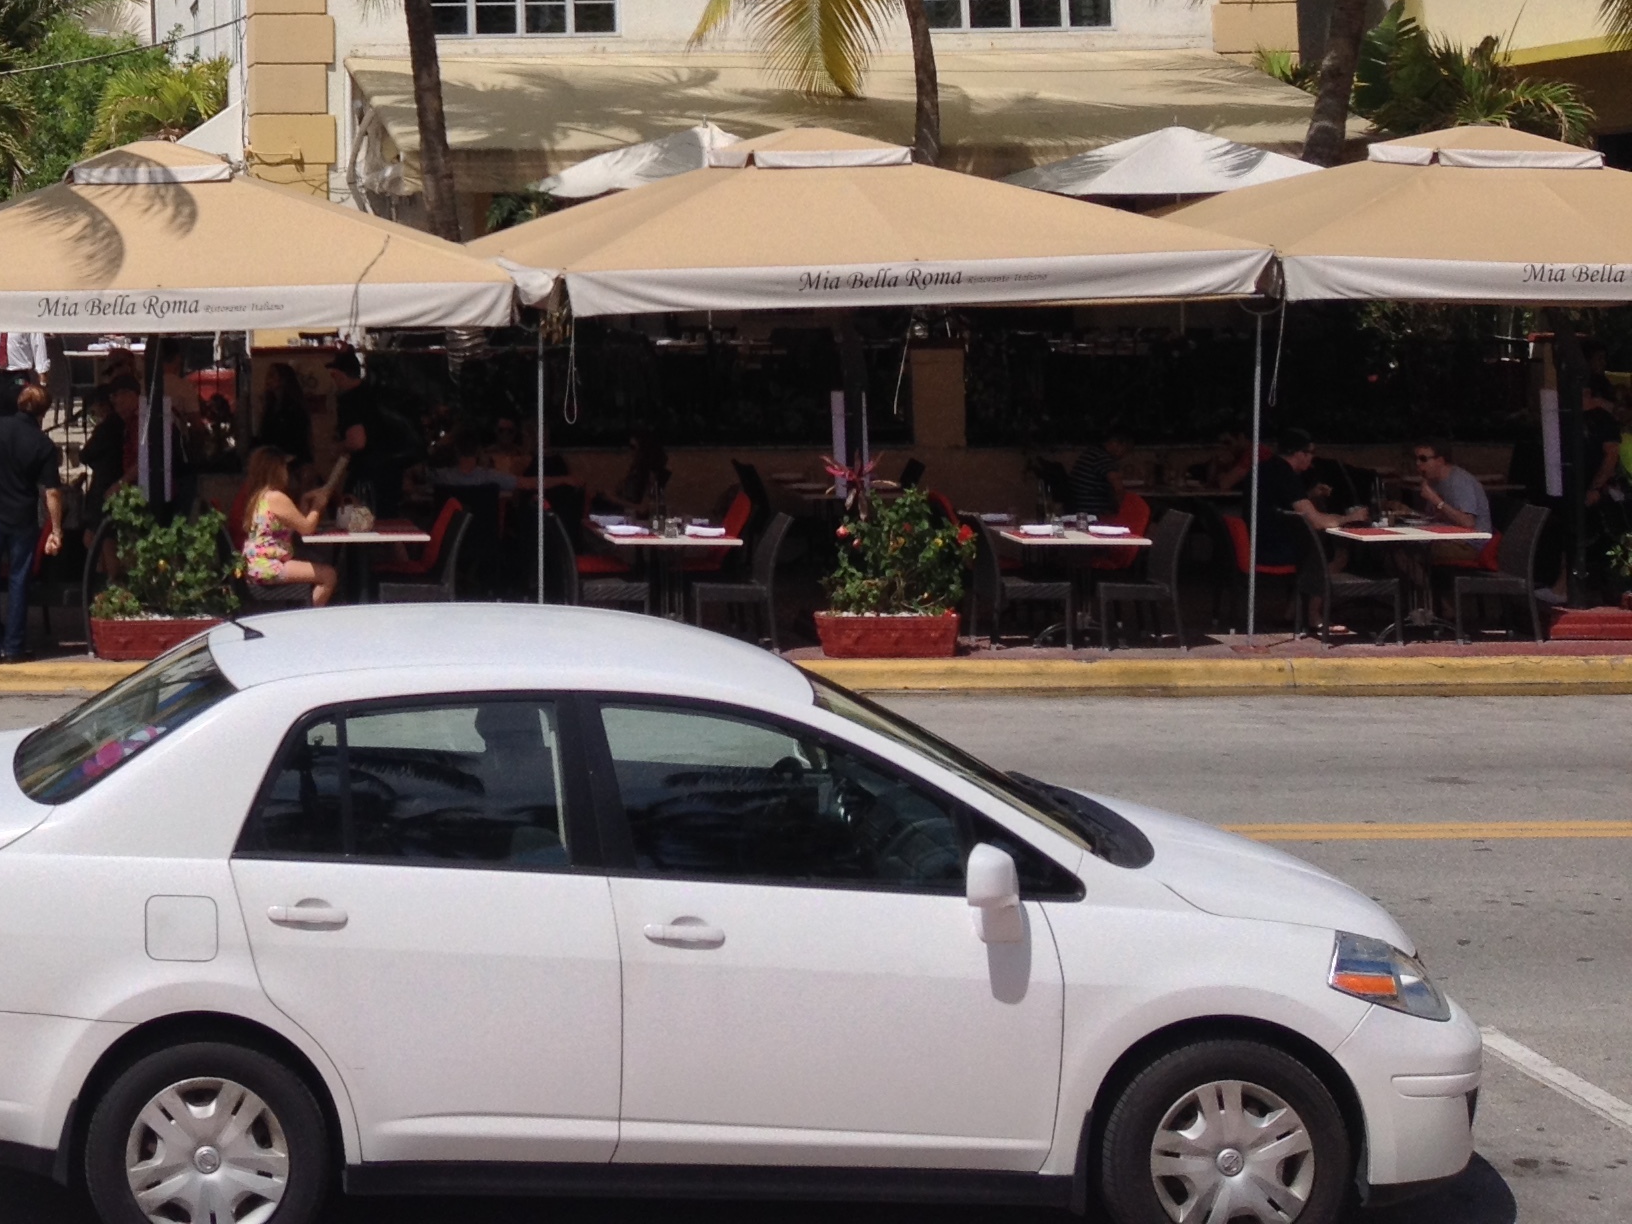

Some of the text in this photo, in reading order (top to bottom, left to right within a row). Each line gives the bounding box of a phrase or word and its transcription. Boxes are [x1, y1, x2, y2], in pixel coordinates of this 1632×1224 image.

[798, 270, 841, 291] Mia
[847, 268, 899, 290] Bella
[905, 267, 963, 290] Roma
[1522, 263, 1627, 283] Mia Bella
[37, 296, 80, 318] Mia
[84, 294, 137, 316] Bella
[143, 295, 200, 318] Roma
